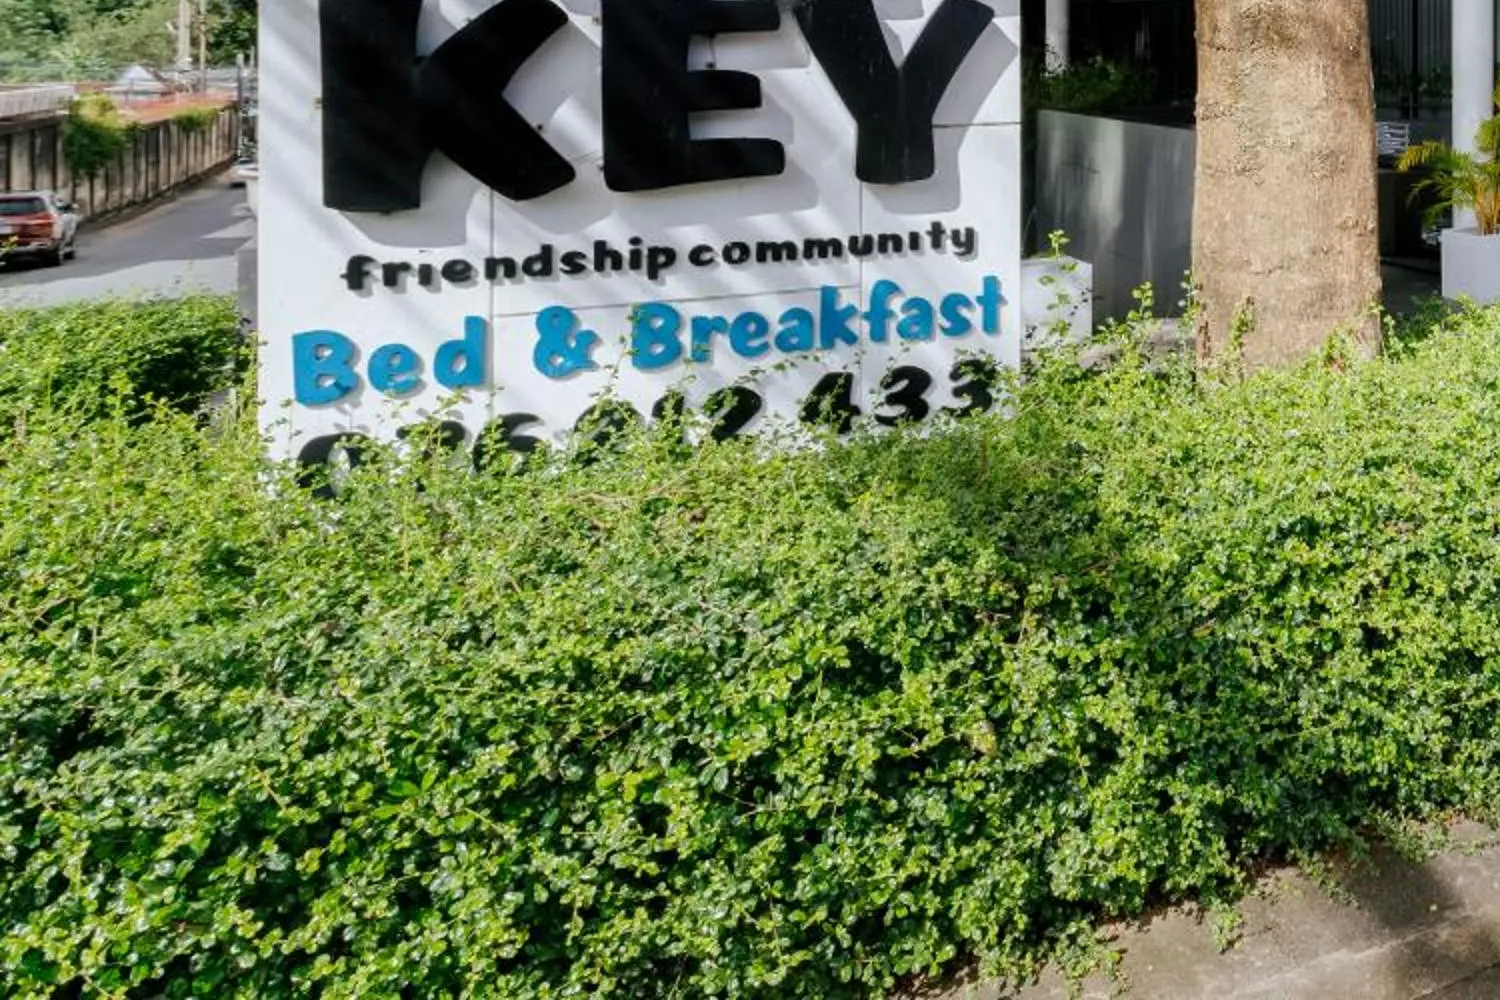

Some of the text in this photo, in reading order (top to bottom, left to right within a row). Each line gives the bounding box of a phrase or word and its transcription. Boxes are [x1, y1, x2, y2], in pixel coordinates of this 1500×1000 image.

[292, 275, 1008, 407] Bed & Breakfast
